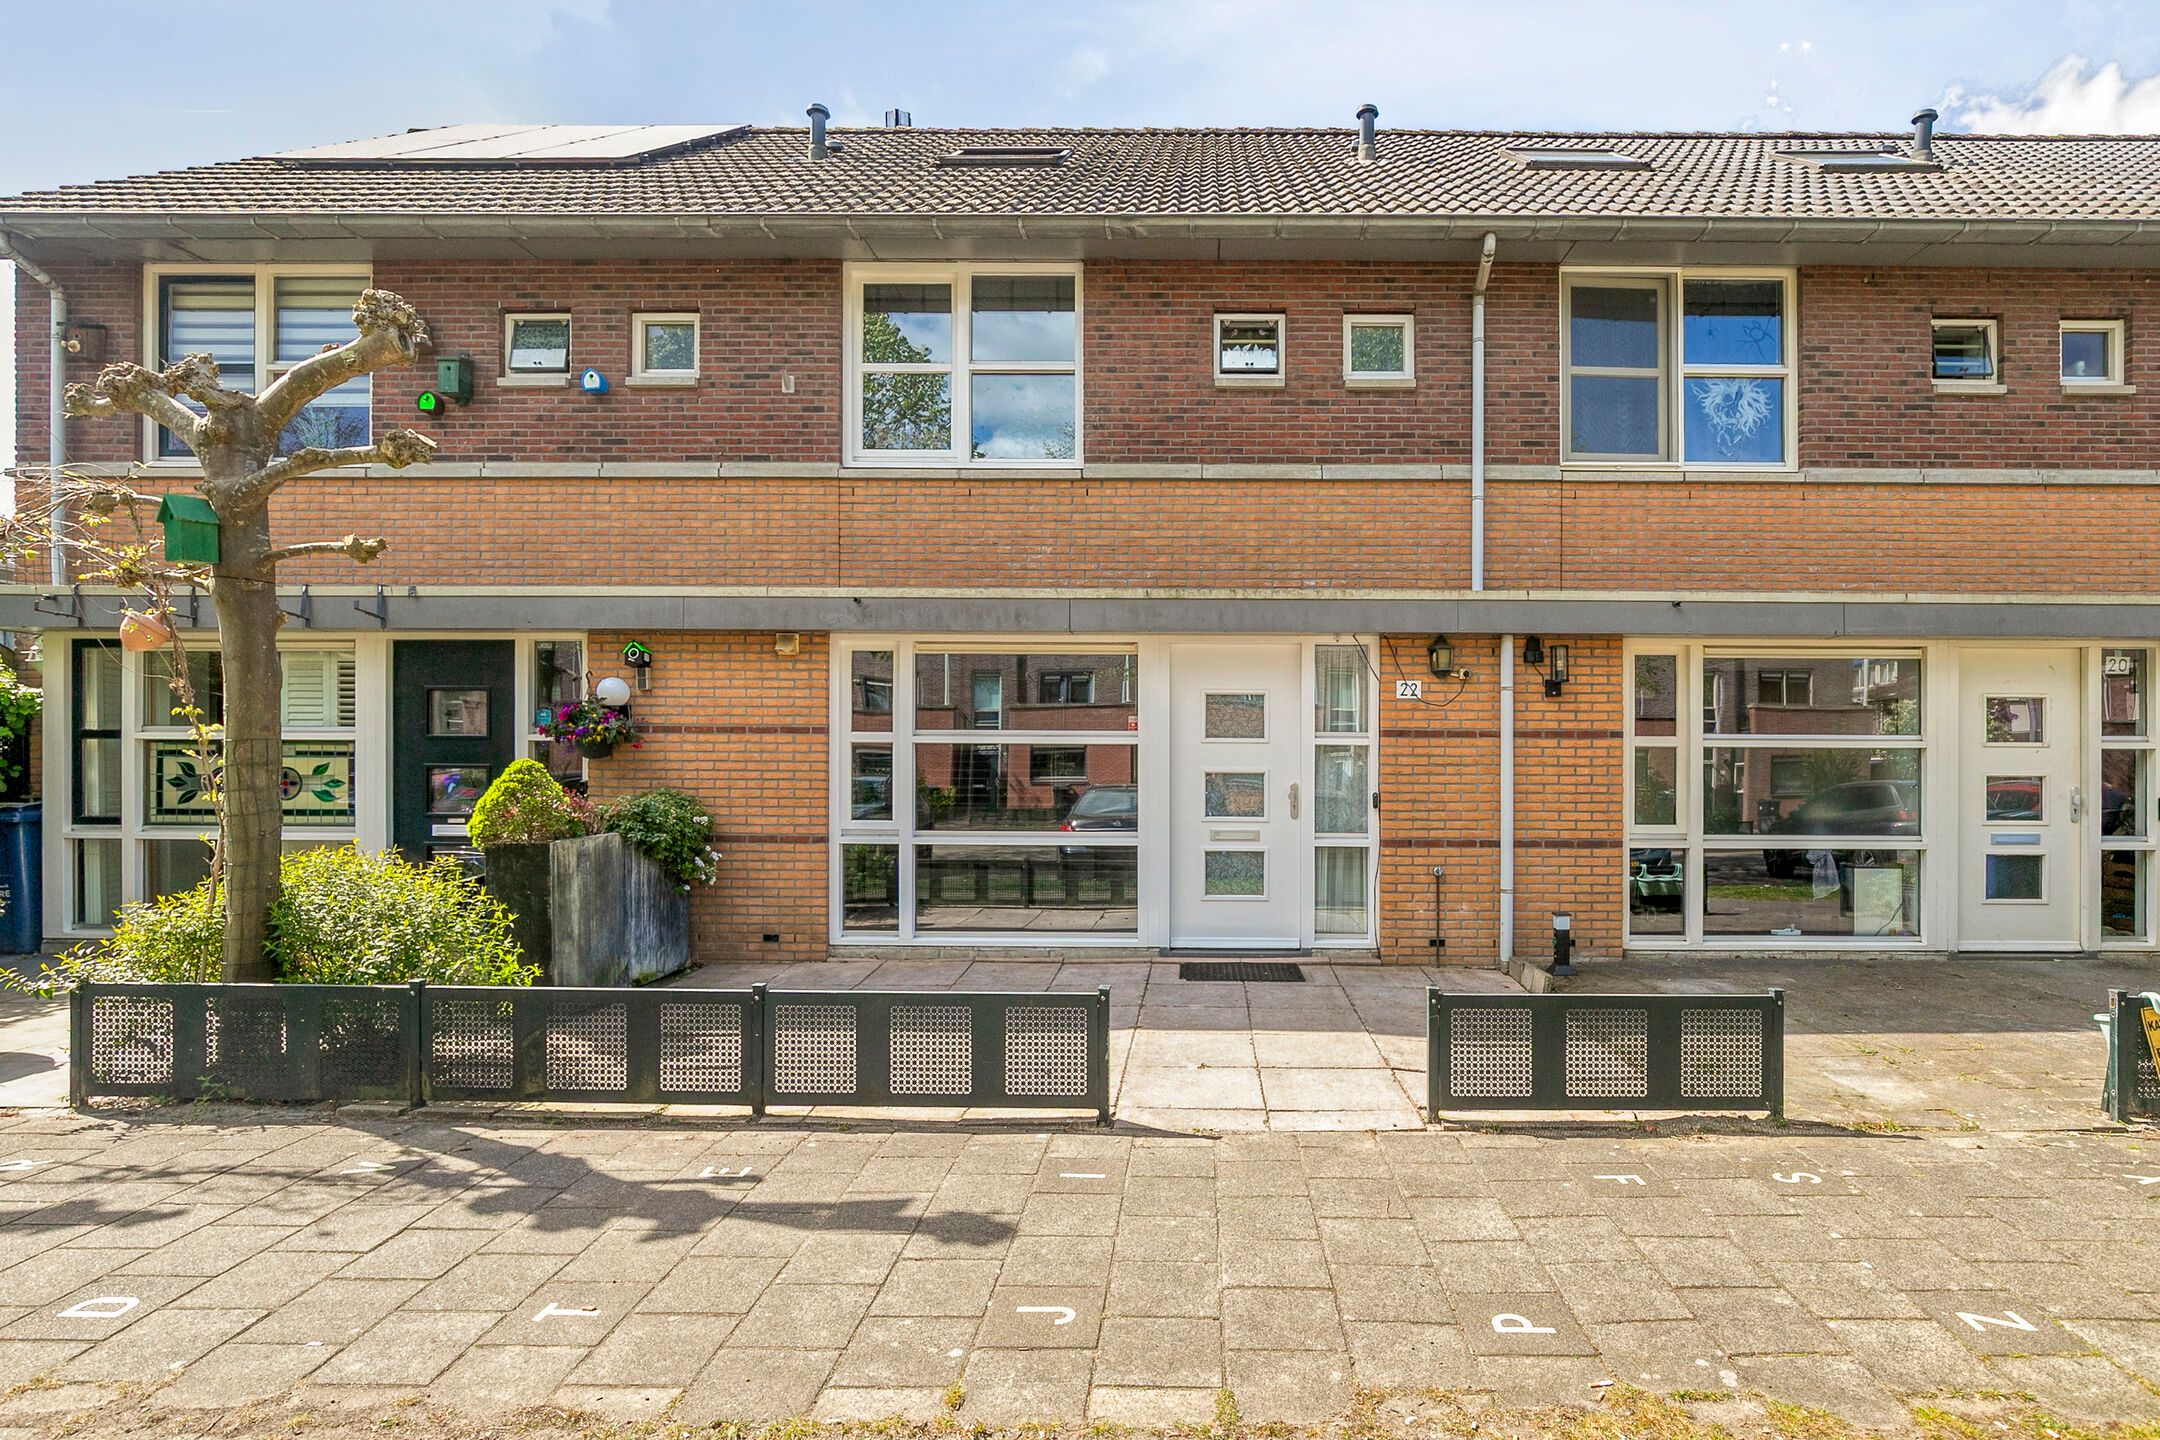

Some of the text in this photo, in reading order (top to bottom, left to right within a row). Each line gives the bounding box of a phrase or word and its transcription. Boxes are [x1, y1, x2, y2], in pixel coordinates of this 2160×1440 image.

[2109, 658, 2127, 672] 20
[1400, 682, 1418, 696] 22
[340, 1160, 396, 1175] V
[697, 1166, 753, 1178] E
[1593, 1174, 1647, 1186] F
[1771, 1172, 1822, 1184] S
[56, 1294, 141, 1320] D
[531, 1302, 602, 1323] T
[1015, 1305, 1077, 1325] J
[1491, 1313, 1558, 1334] P
